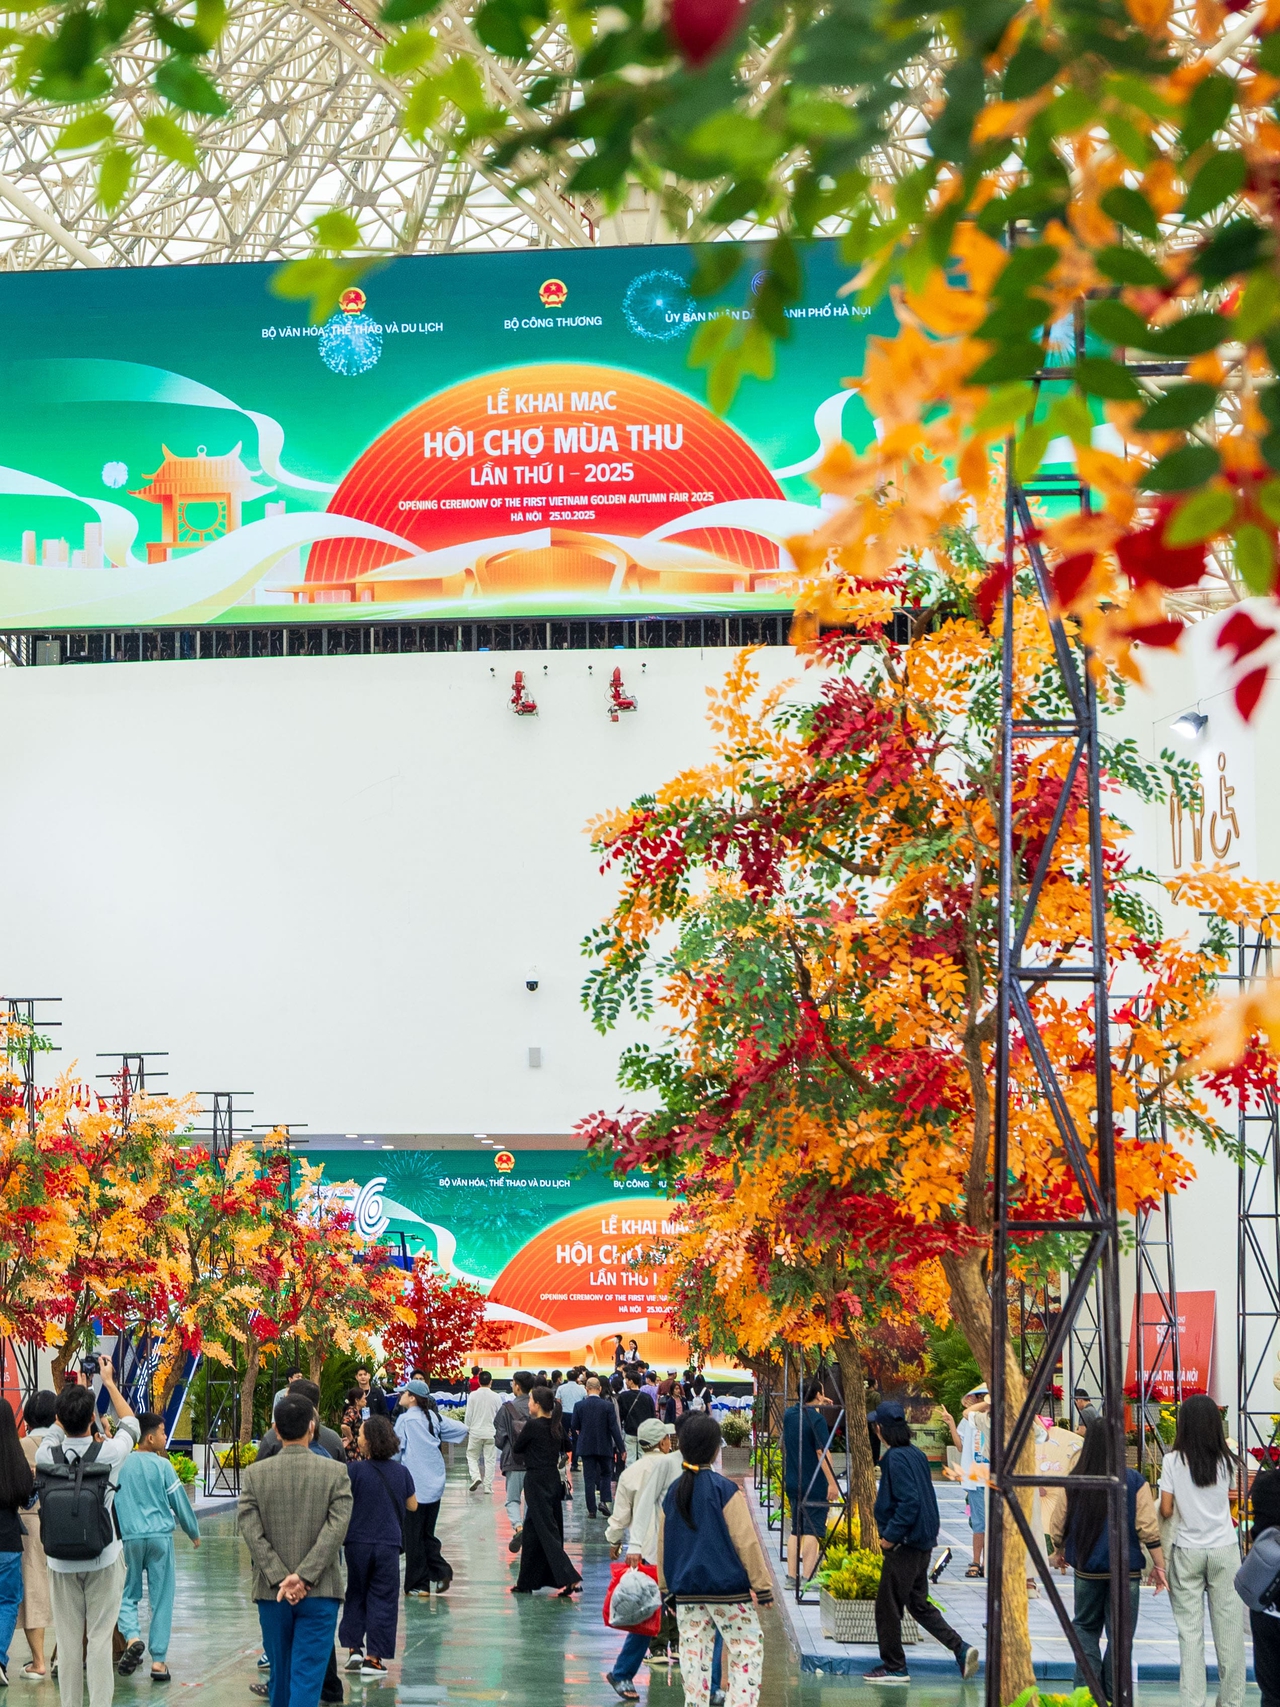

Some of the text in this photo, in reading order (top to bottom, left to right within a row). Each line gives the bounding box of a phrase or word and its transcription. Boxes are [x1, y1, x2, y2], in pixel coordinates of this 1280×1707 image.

[665, 310, 680, 324] ỦY
[683, 312, 706, 323] BAN
[808, 303, 832, 318] PHỐ
[834, 303, 849, 317] HÀ
[262, 326, 276, 340] BỘ
[278, 326, 301, 337] VĂN
[302, 324, 326, 338] HÓA,
[354, 324, 383, 335] THAO
[385, 321, 399, 334] VÀ
[401, 324, 417, 333] DU
[418, 322, 444, 334] LỊCH
[504, 316, 603, 332] BỘ CÔNG THƯƠNG
[487, 387, 617, 415] LỄ KHAI MẠC
[424, 422, 683, 460] HỘI CHỢ MÙA THU
[470, 462, 508, 486] LẦN
[514, 462, 553, 484] THỨ
[558, 464, 564, 483] I
[584, 462, 634, 482] 2025
[398, 492, 714, 510] OPENING CEREMONY OF THE FIRST VIETNAM GOLDEN AUTUMN FAIR 2025
[510, 511, 596, 522] HÀ NỘI 25.10.2025
[439, 1178, 450, 1188] BỘ
[452, 1178, 469, 1186] VĂN
[469, 1178, 488, 1188] HÓA,
[489, 1176, 504, 1186] THỂ
[528, 1178, 538, 1186] VÀ
[552, 1180, 570, 1189] LỊCH
[626, 1179, 650, 1188] CÔNG
[602, 1214, 618, 1235] LỄ
[622, 1220, 656, 1235] KHAI
[556, 1241, 592, 1266] HỘI
[590, 1268, 616, 1286] LẦN
[604, 1294, 614, 1302] OF
[615, 1294, 626, 1302] THE
[628, 1294, 644, 1302] FIRST
[618, 1305, 628, 1313] HÀ
[630, 1305, 642, 1314] NỘI
